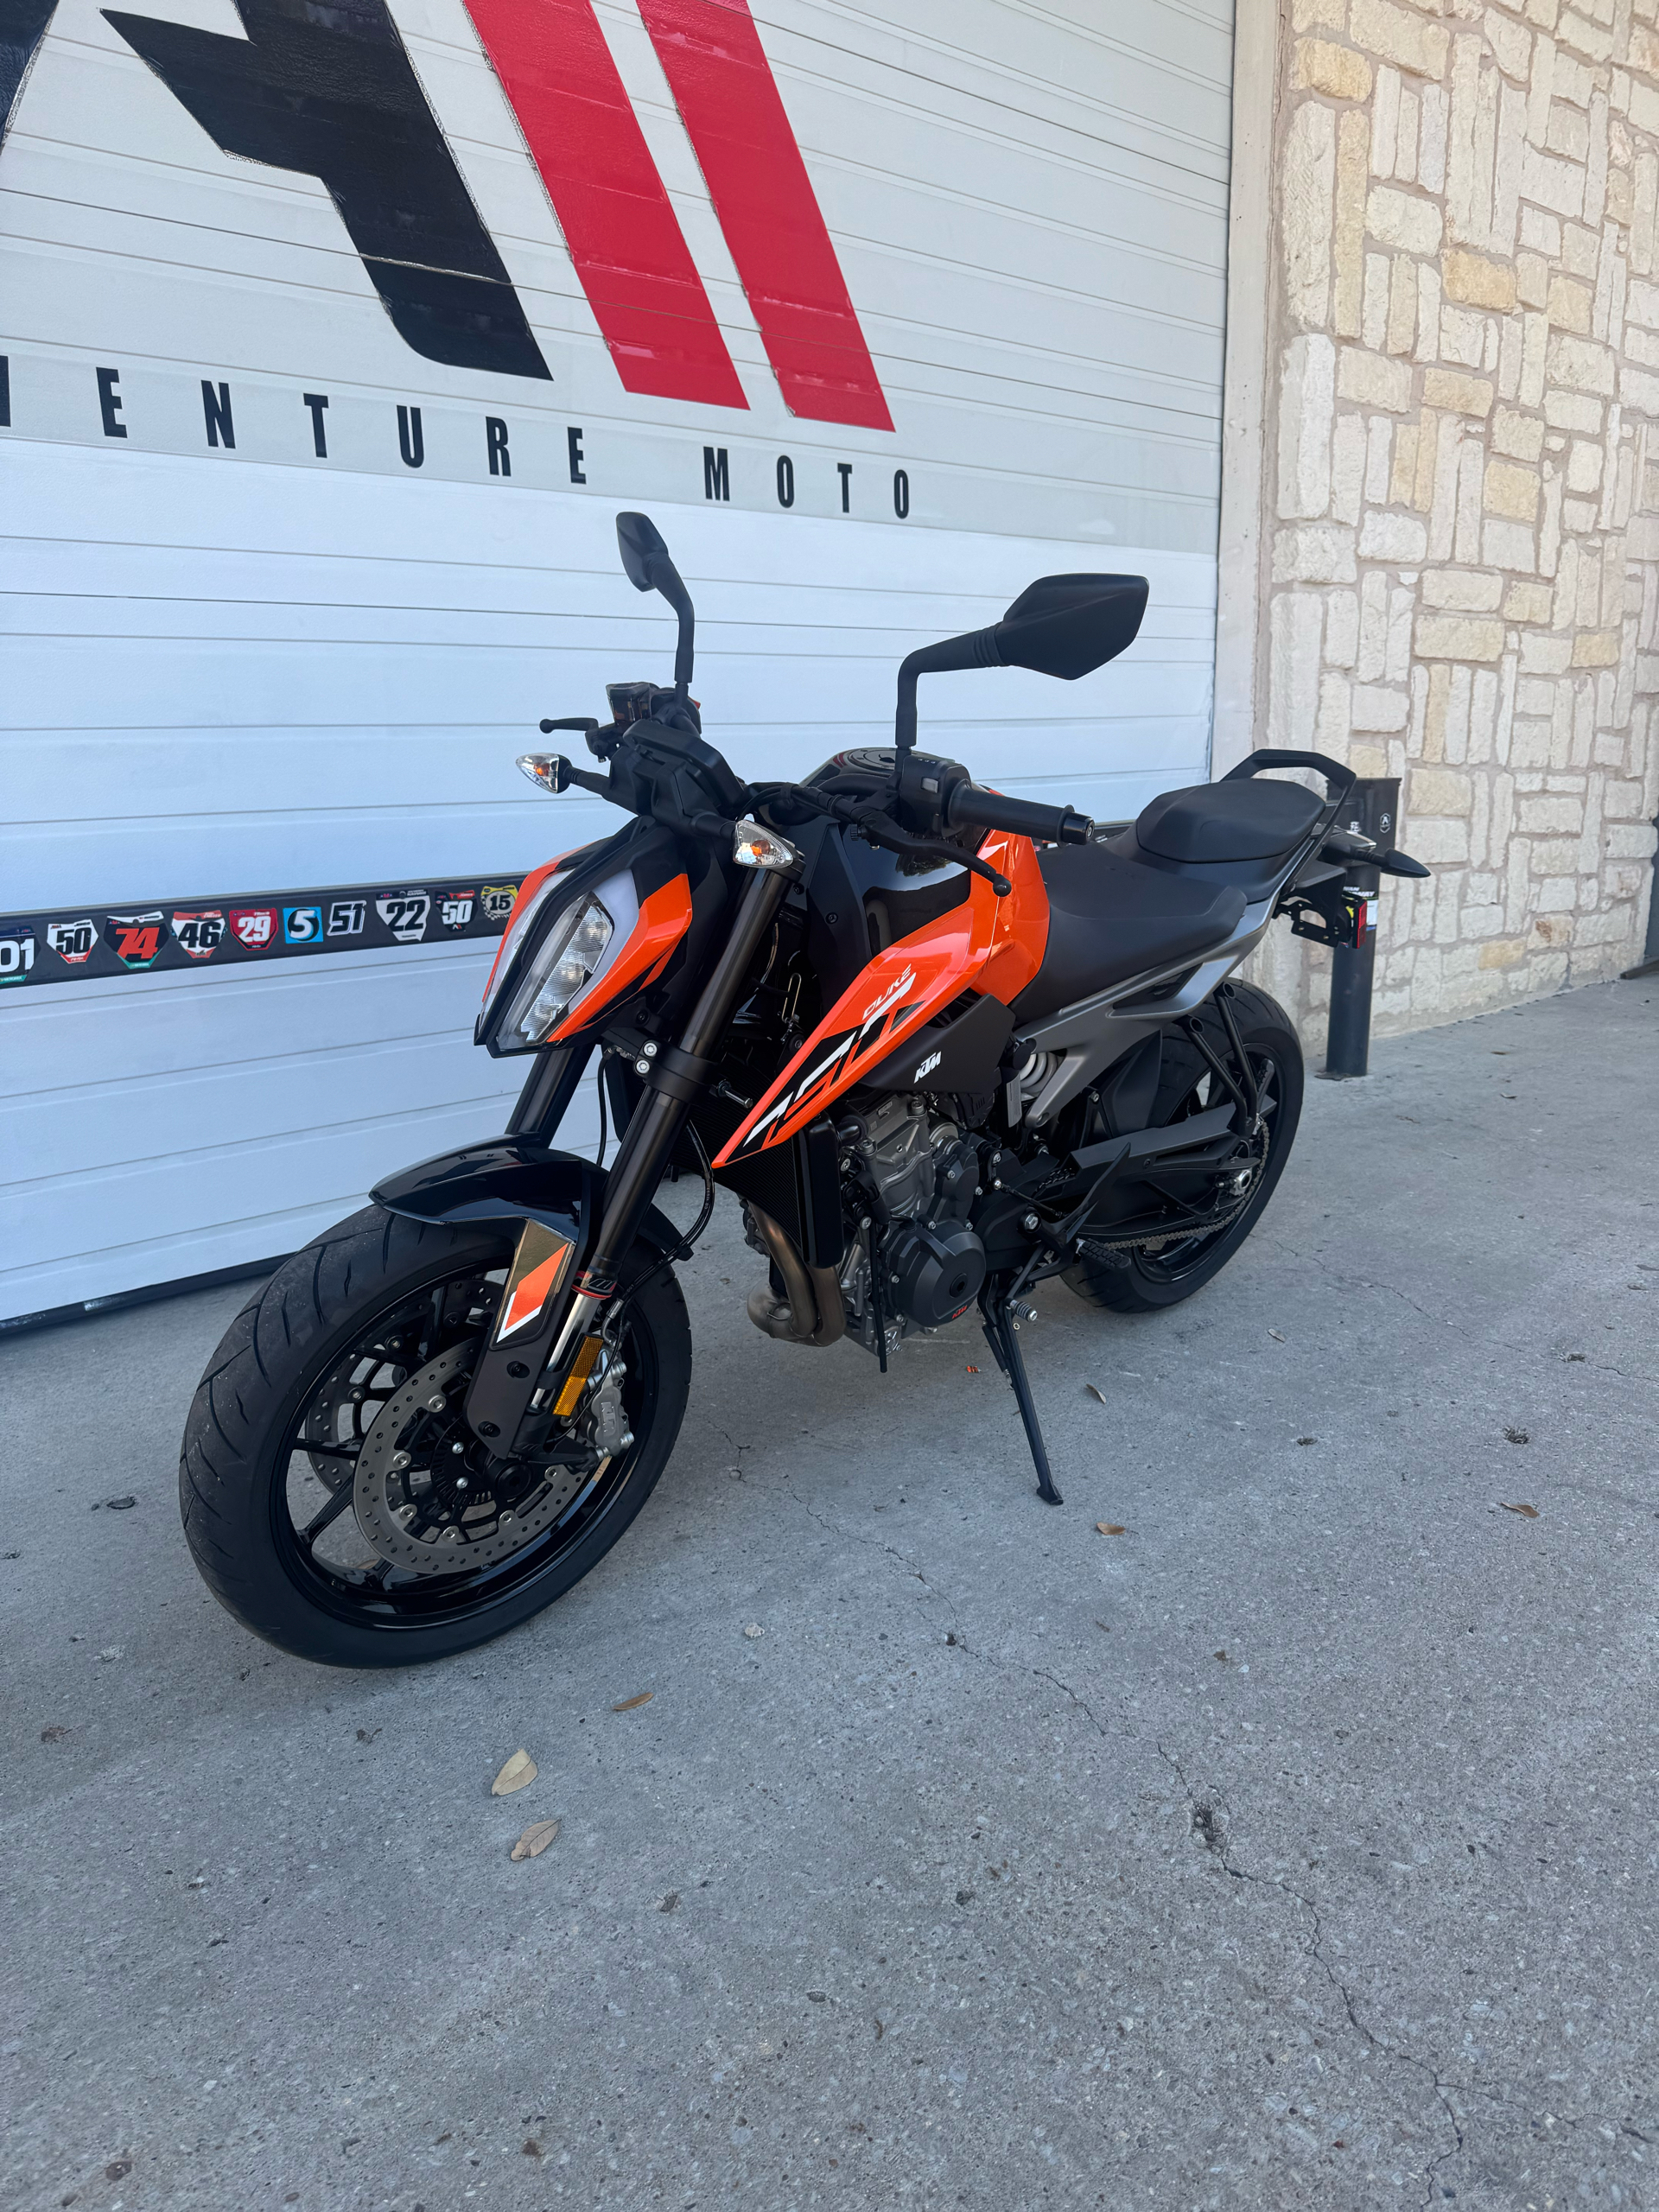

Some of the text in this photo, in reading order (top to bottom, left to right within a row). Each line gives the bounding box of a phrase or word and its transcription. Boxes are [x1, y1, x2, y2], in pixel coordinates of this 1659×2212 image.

[0, 354, 910, 519] ENTURE MOTO
[327, 900, 366, 936] 51
[385, 899, 426, 932] 22
[442, 899, 474, 925] 50
[489, 894, 512, 911] 15
[178, 921, 222, 949] 46
[238, 916, 271, 943] 29
[289, 910, 316, 939] 5
[55, 926, 92, 956] 50
[115, 926, 160, 959] 74
[862, 963, 912, 1021] DUKE
[913, 1051, 942, 1084] KTM
